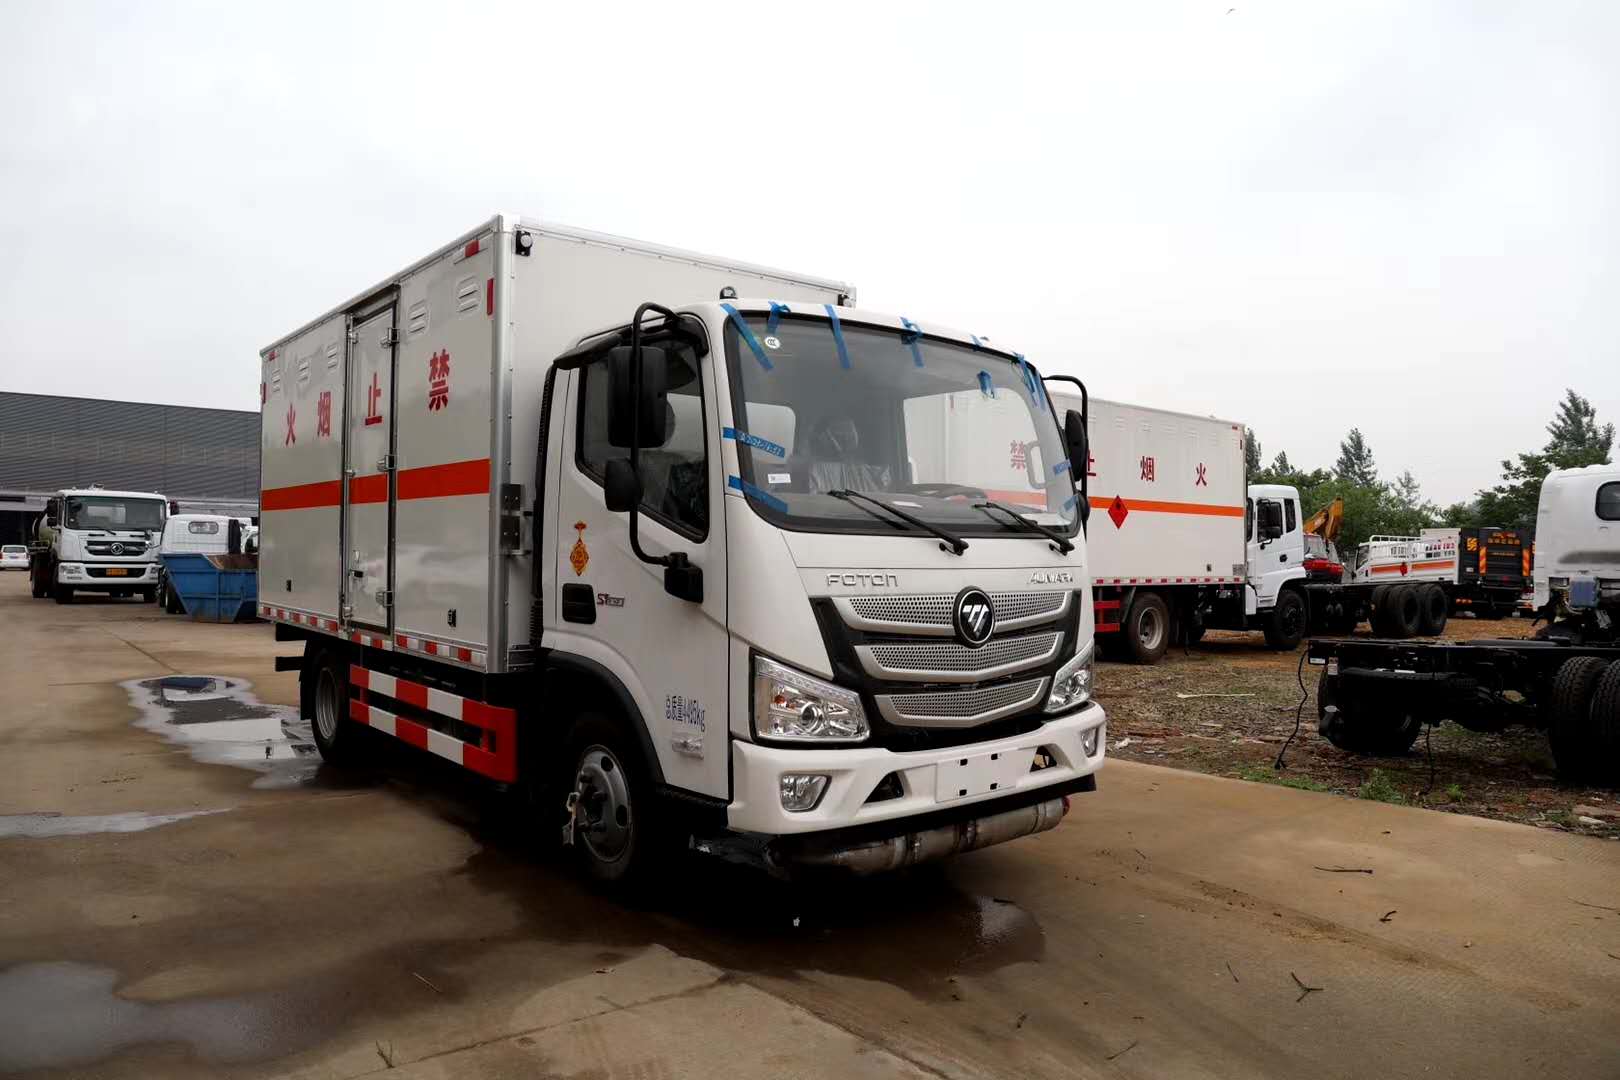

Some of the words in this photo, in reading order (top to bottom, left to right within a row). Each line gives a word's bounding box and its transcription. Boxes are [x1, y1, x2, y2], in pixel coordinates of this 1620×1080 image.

[364, 372, 383, 426] 止
[428, 348, 450, 412] 禁
[285, 402, 296, 447] 火
[317, 391, 331, 437] 烟
[1140, 456, 1155, 482] 烟
[1195, 462, 1207, 486] 火
[826, 573, 898, 588] FOTON
